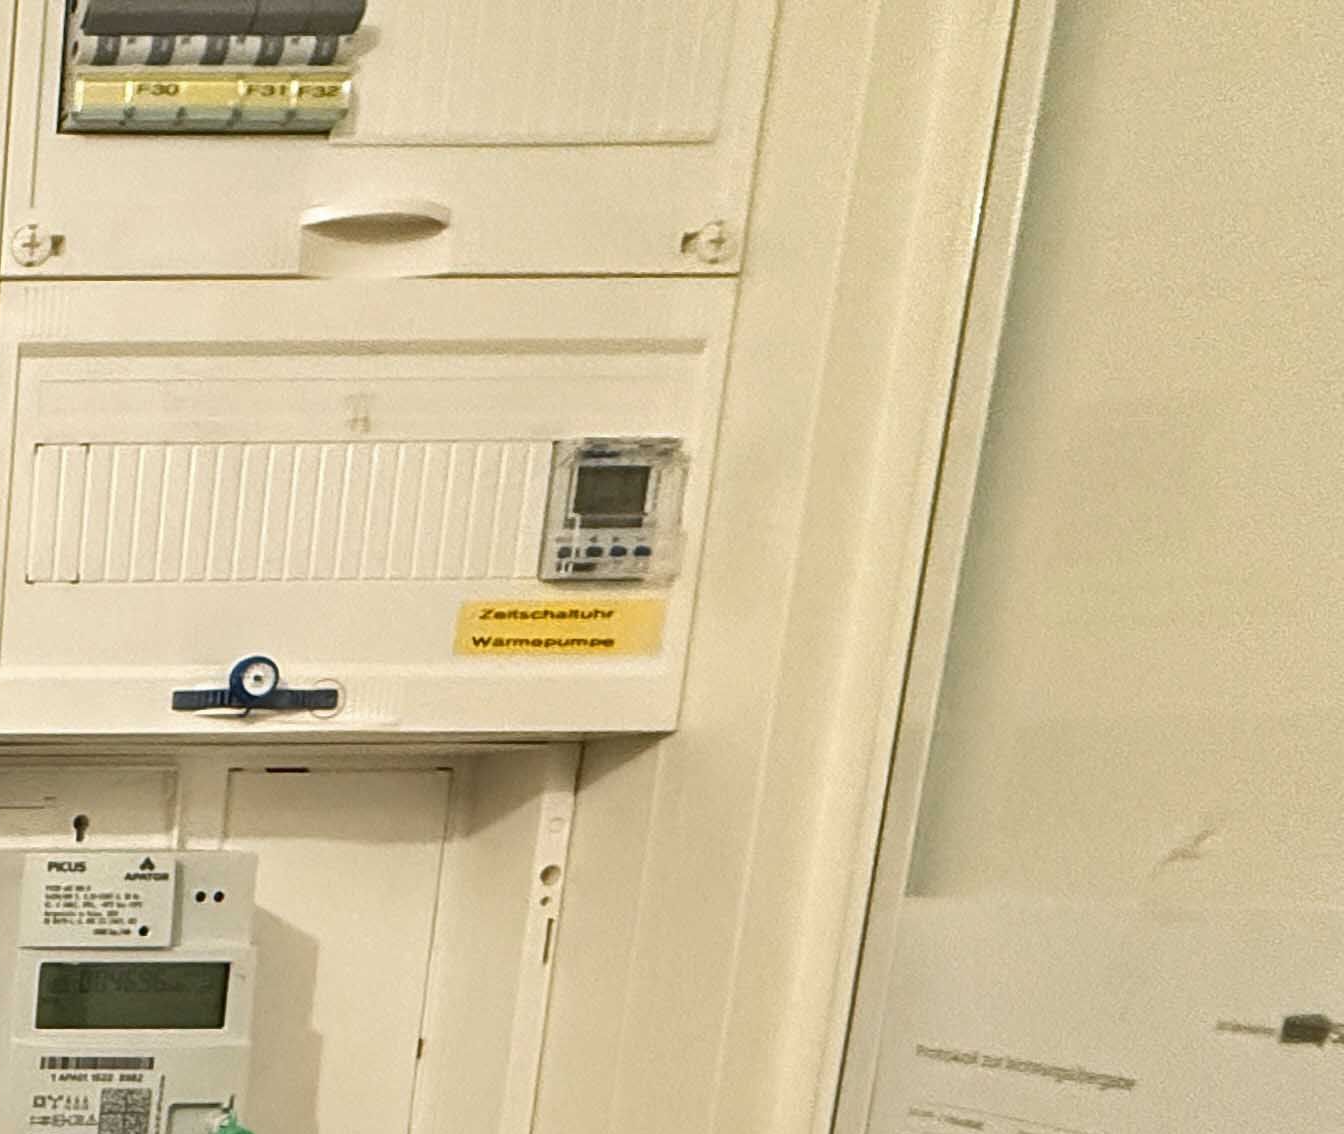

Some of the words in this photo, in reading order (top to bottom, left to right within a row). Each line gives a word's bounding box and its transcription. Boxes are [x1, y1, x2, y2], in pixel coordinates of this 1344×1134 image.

[135, 83, 180, 97] F30
[246, 83, 286, 97] F31
[298, 84, 341, 98] F32
[479, 608, 615, 620] Zeitschaltuhr
[471, 635, 616, 649] Wärmepumpe
[48, 861, 87, 873] PICUS
[124, 872, 170, 881] APATOR
